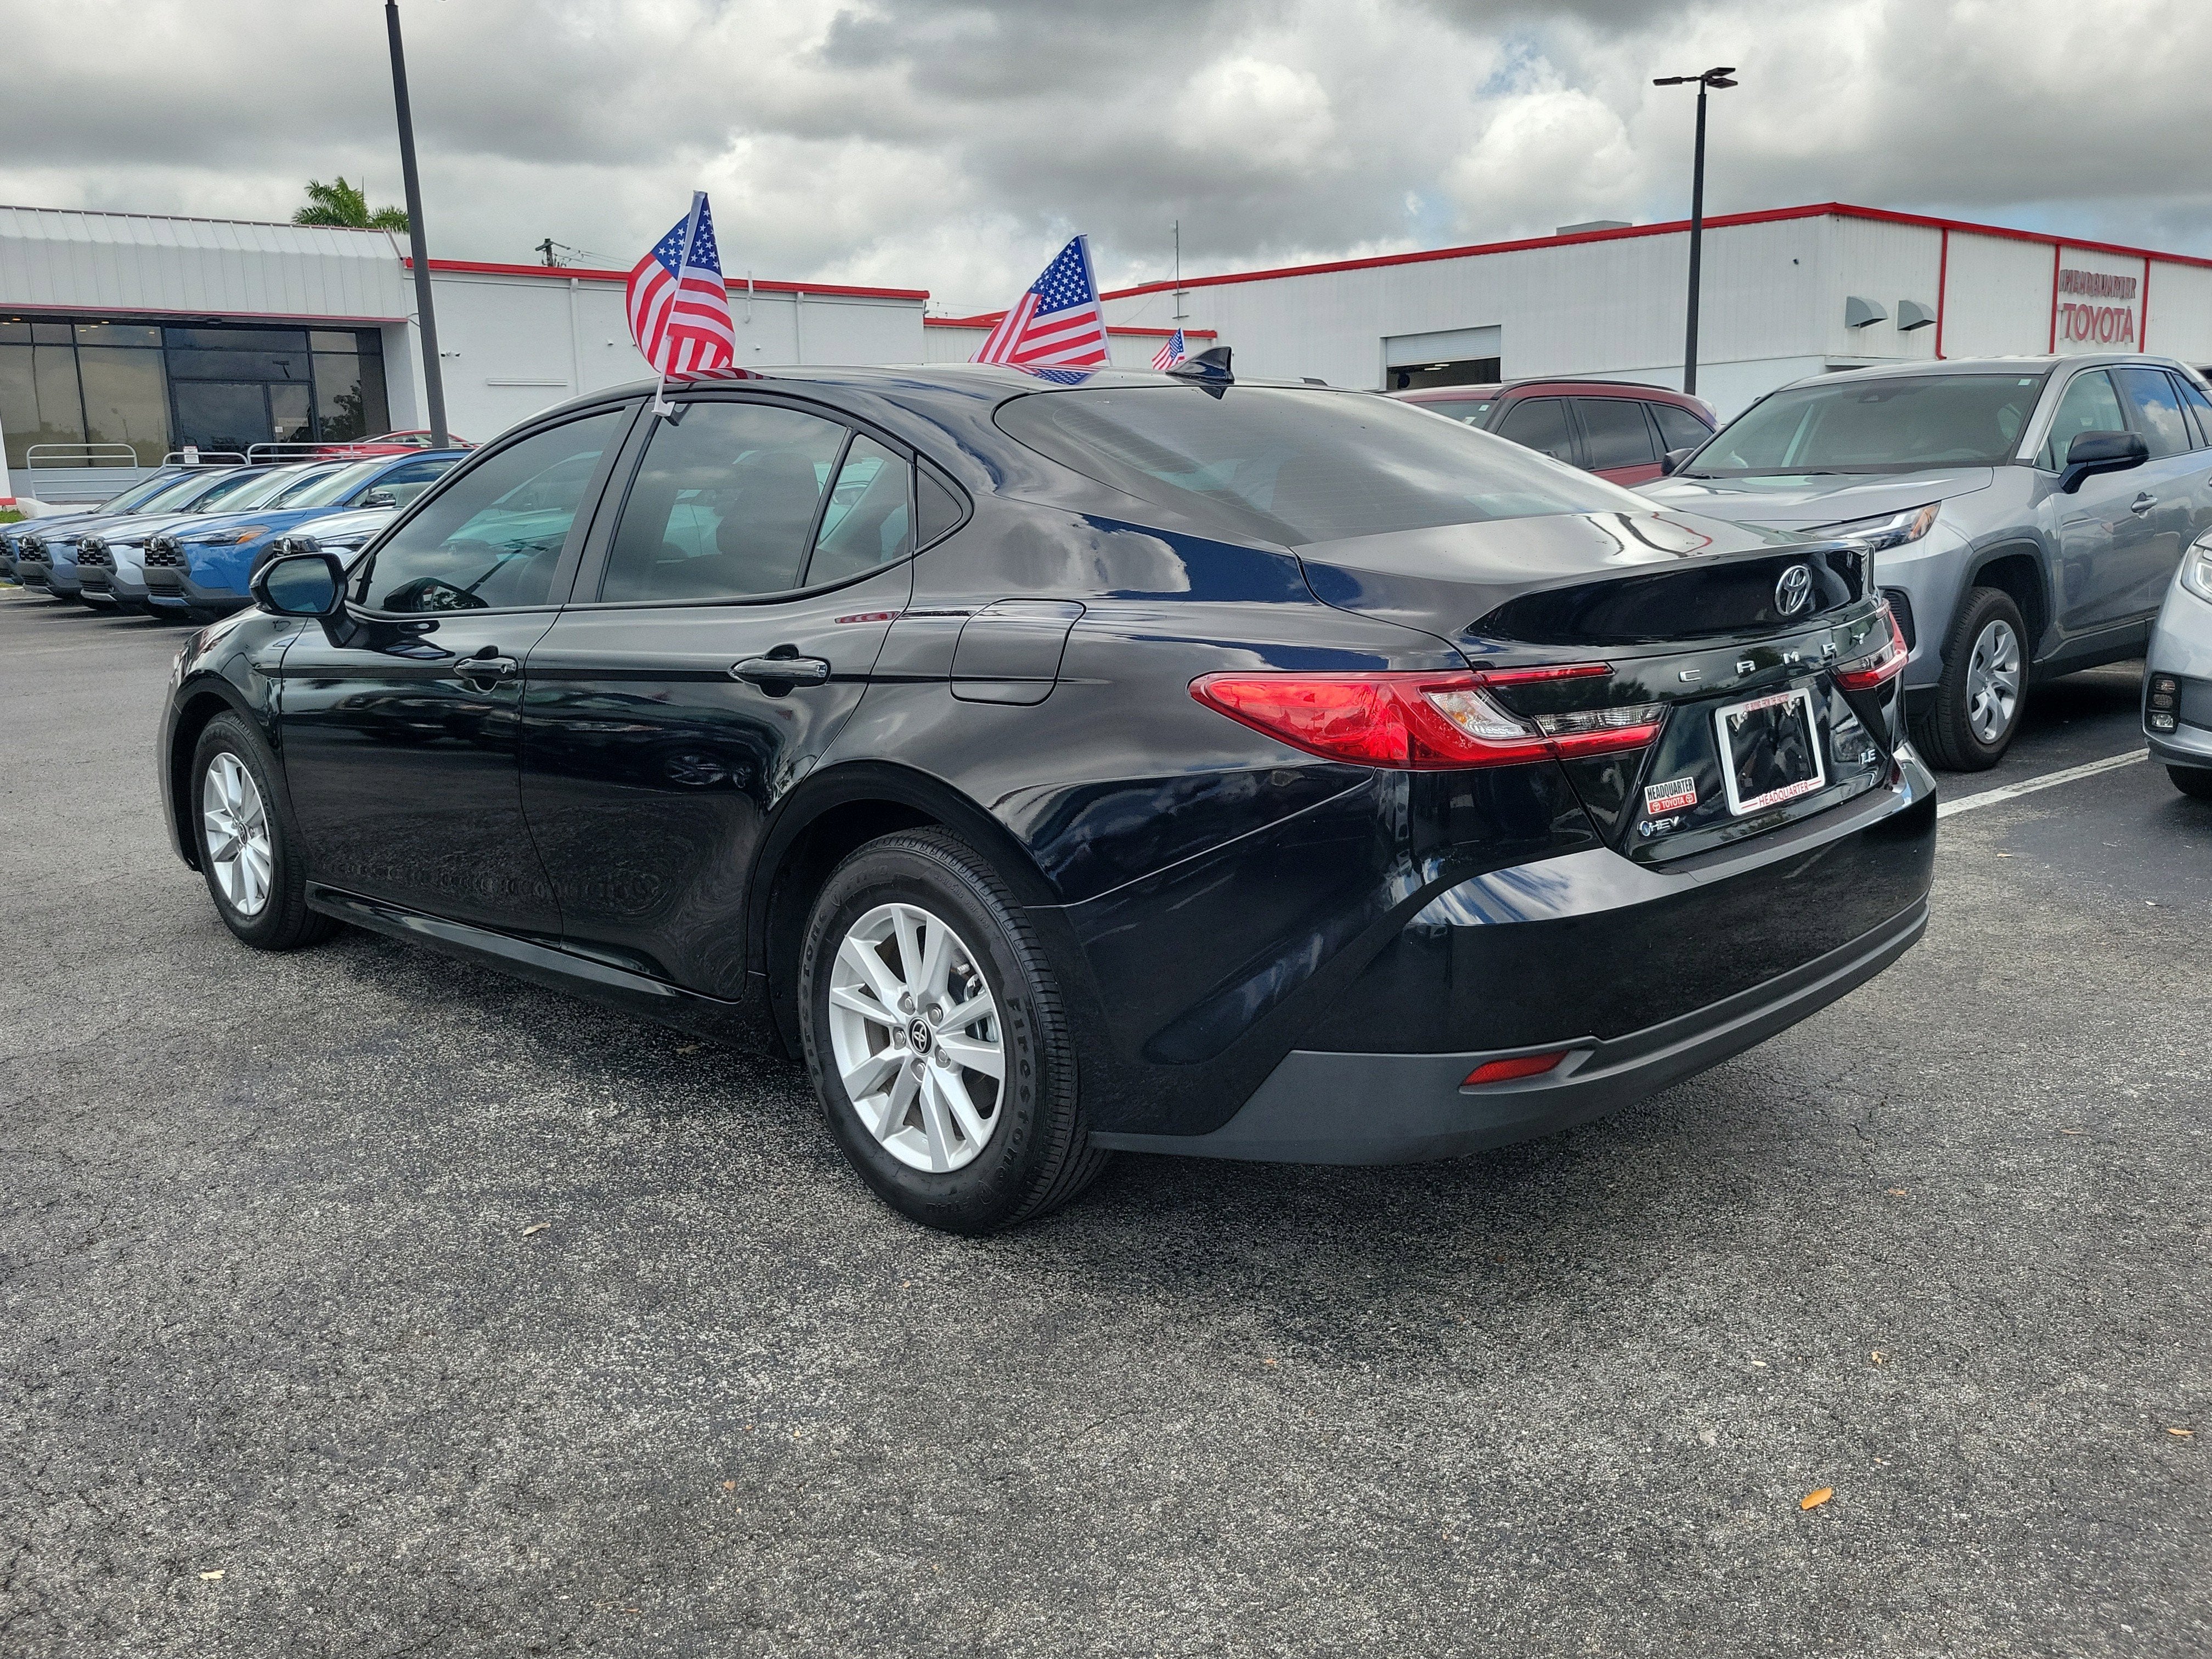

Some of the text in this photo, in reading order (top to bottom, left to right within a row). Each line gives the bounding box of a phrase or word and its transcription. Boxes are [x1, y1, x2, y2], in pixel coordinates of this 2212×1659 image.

[2063, 303, 2134, 343] TOYOTA
[1860, 749, 1876, 765] LE
[1647, 778, 1694, 802] HEADQUARTER
[1758, 782, 1809, 806] HEADQUARTER
[1661, 797, 1685, 809] TOYOTA
[1648, 815, 1680, 832] HEV
